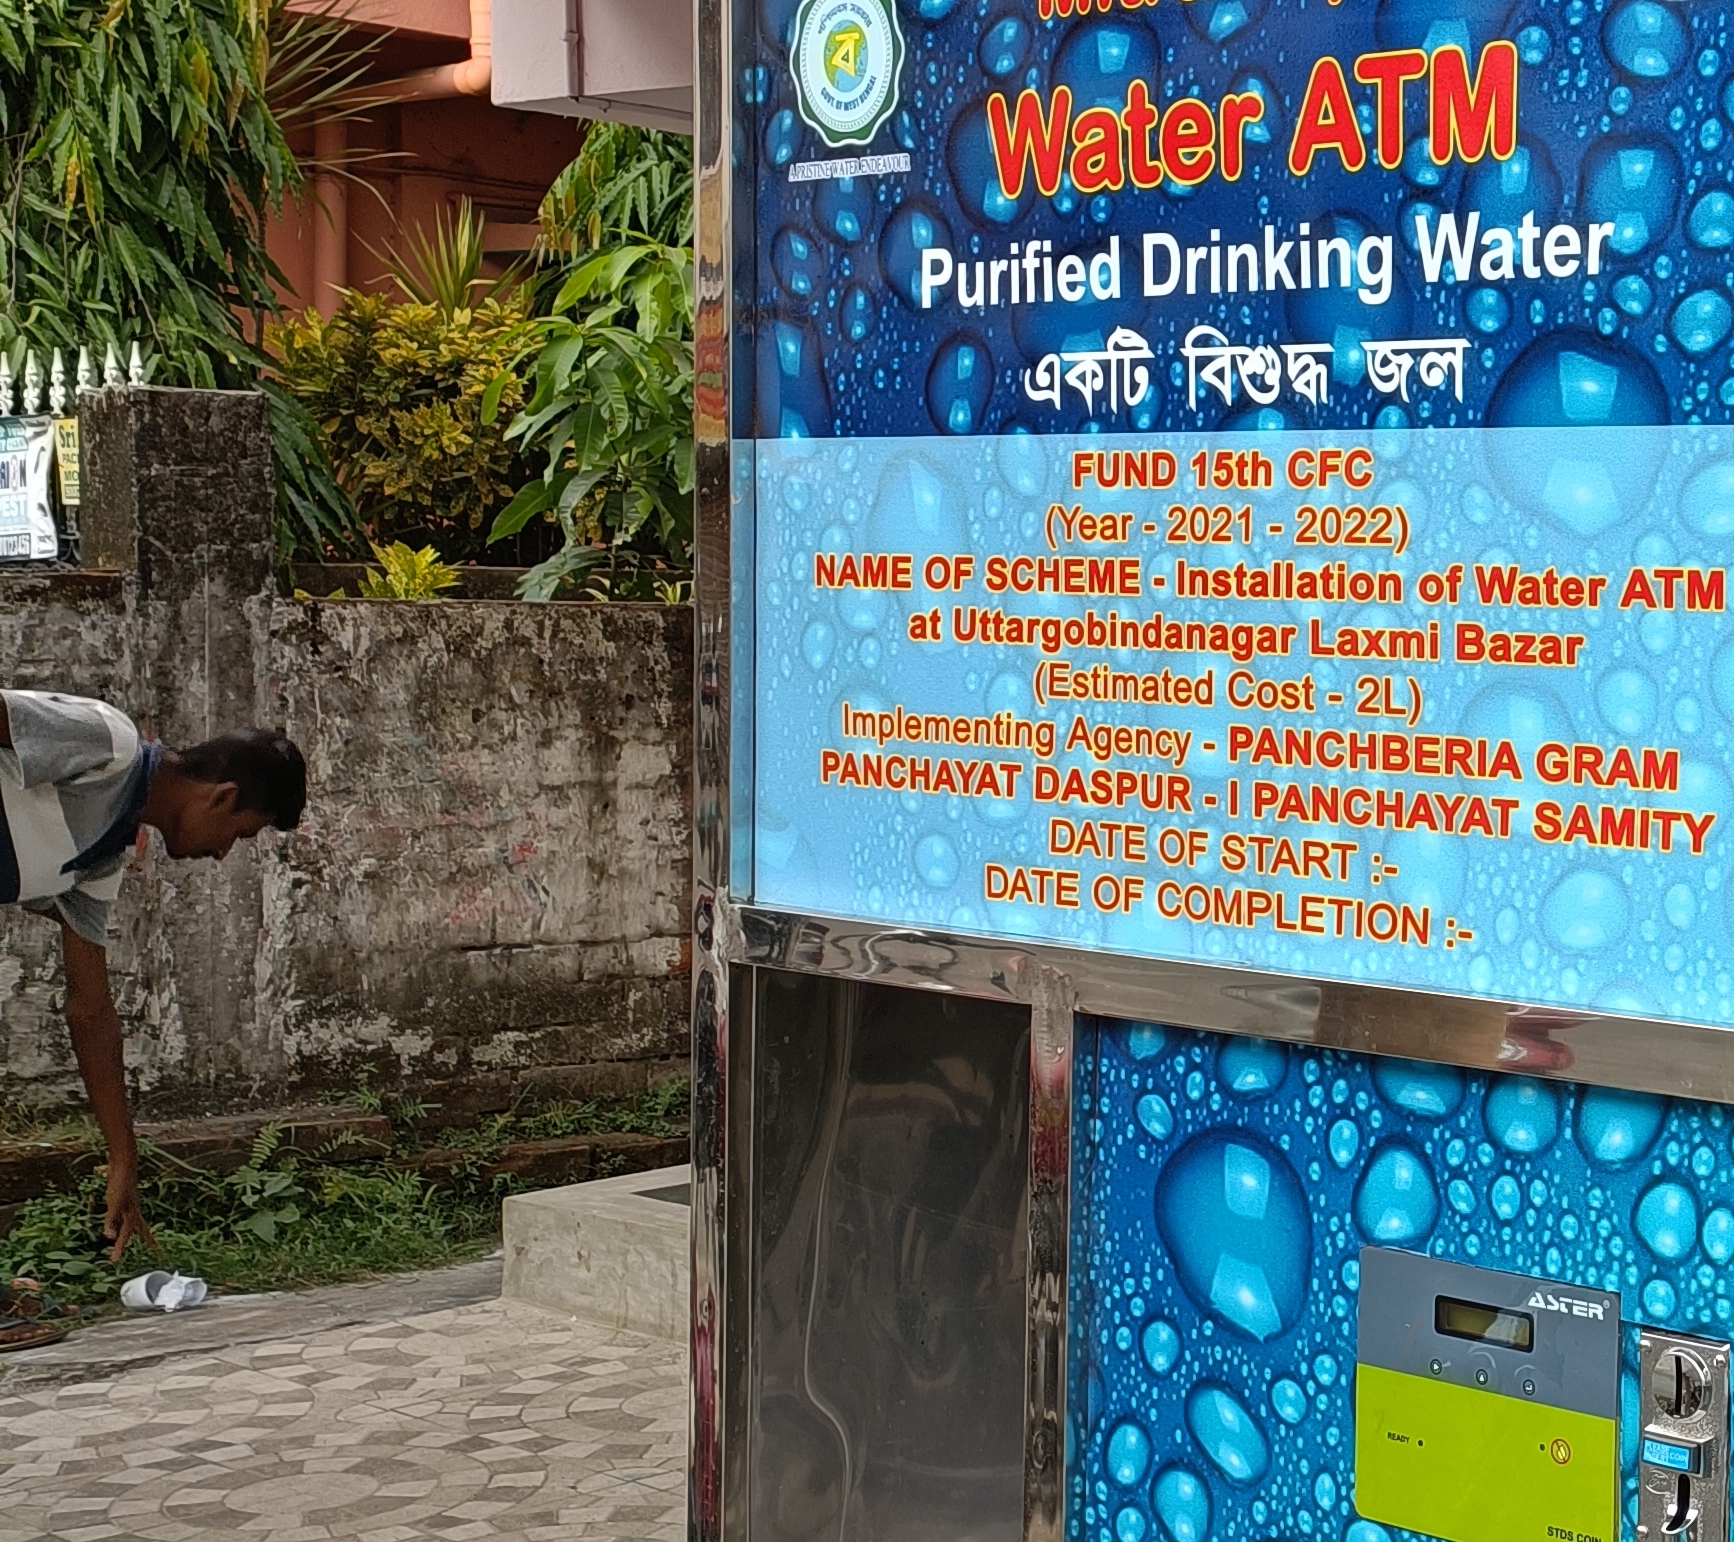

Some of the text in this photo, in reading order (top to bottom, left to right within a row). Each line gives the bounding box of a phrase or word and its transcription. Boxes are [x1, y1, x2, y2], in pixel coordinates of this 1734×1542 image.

[987, 40, 1518, 200] Water ATM
[919, 210, 1614, 309] Purified Drinking Water
[1023, 325, 1470, 414] একটি বিশুদ্ধ জল
[1072, 448, 1375, 490] FUND 15th CFC
[1044, 505, 1131, 548] (Year
[1166, 507, 1256, 545] 2021
[1295, 506, 1410, 551] 2022)
[813, 554, 914, 591] NAME
[923, 556, 976, 593] OF
[984, 557, 1140, 598] SCHEME
[1175, 561, 1402, 606] Installation
[1417, 566, 1464, 606] of
[1473, 566, 1607, 608] Water
[1618, 566, 1726, 612] ATM
[907, 608, 1584, 667] at Uttargobindanagar Laxmi Bazar
[1034, 660, 1215, 711] (Estimated
[1225, 670, 1317, 714] Cost
[1354, 674, 1424, 724] 2L)
[841, 701, 1058, 756] Implementing
[1066, 716, 1192, 765] Agency
[1227, 726, 1523, 782] PANCHBERIA
[1533, 741, 1681, 791] GRAM
[820, 749, 1022, 799] PANCHAYAT
[1033, 765, 1192, 814] DASPUR
[1251, 784, 1518, 840] PANCHAYAT
[1532, 803, 1717, 855] SAMITY
[1048, 818, 1149, 863] DATE
[1155, 827, 1214, 868] OF
[1220, 833, 1360, 881] START
[983, 863, 1085, 909] DATE
[1092, 872, 1148, 915] OF
[1155, 878, 1432, 947] COMPLETION
[1528, 1291, 1604, 1321] ASTER
[1387, 1431, 1410, 1444] READY
[1547, 1526, 1574, 1541] STDS
